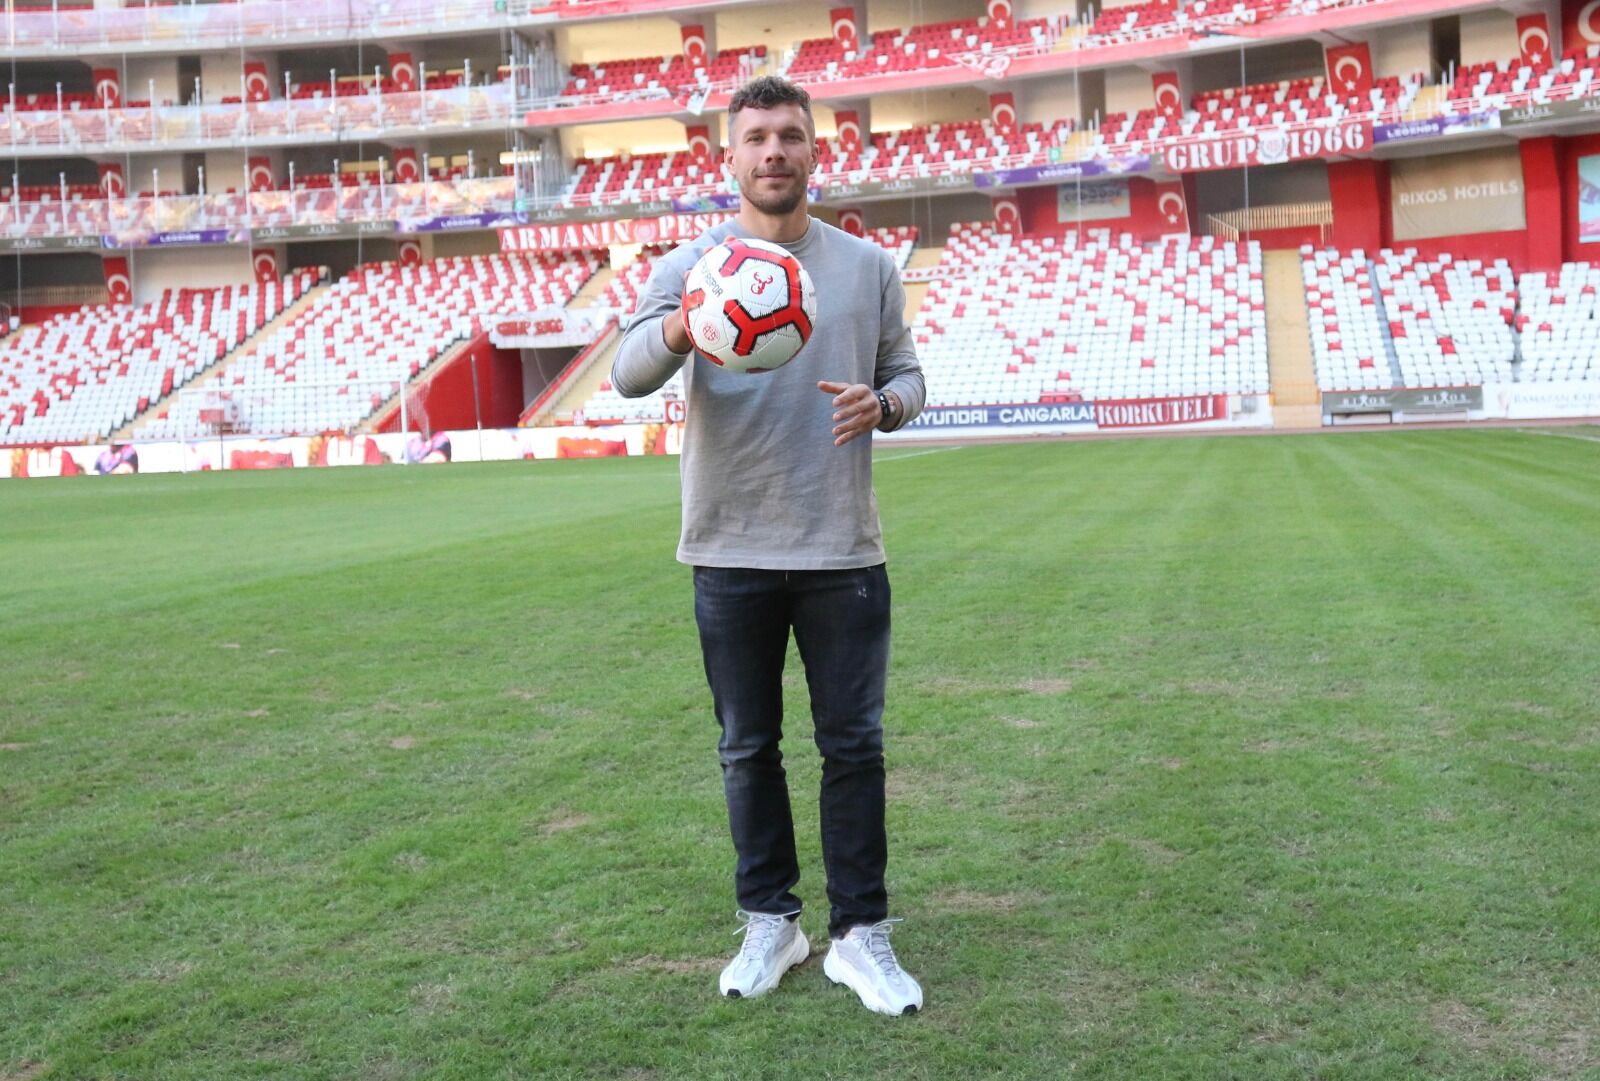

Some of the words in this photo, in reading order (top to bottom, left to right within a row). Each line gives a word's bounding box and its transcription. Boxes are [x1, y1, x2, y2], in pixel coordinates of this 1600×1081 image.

[1167, 138, 1257, 171] GRUP
[1290, 123, 1365, 158] 1966
[1400, 189, 1448, 206] RIXOS
[1454, 180, 1519, 200] HOTELS
[501, 214, 631, 250] ARMANIN
